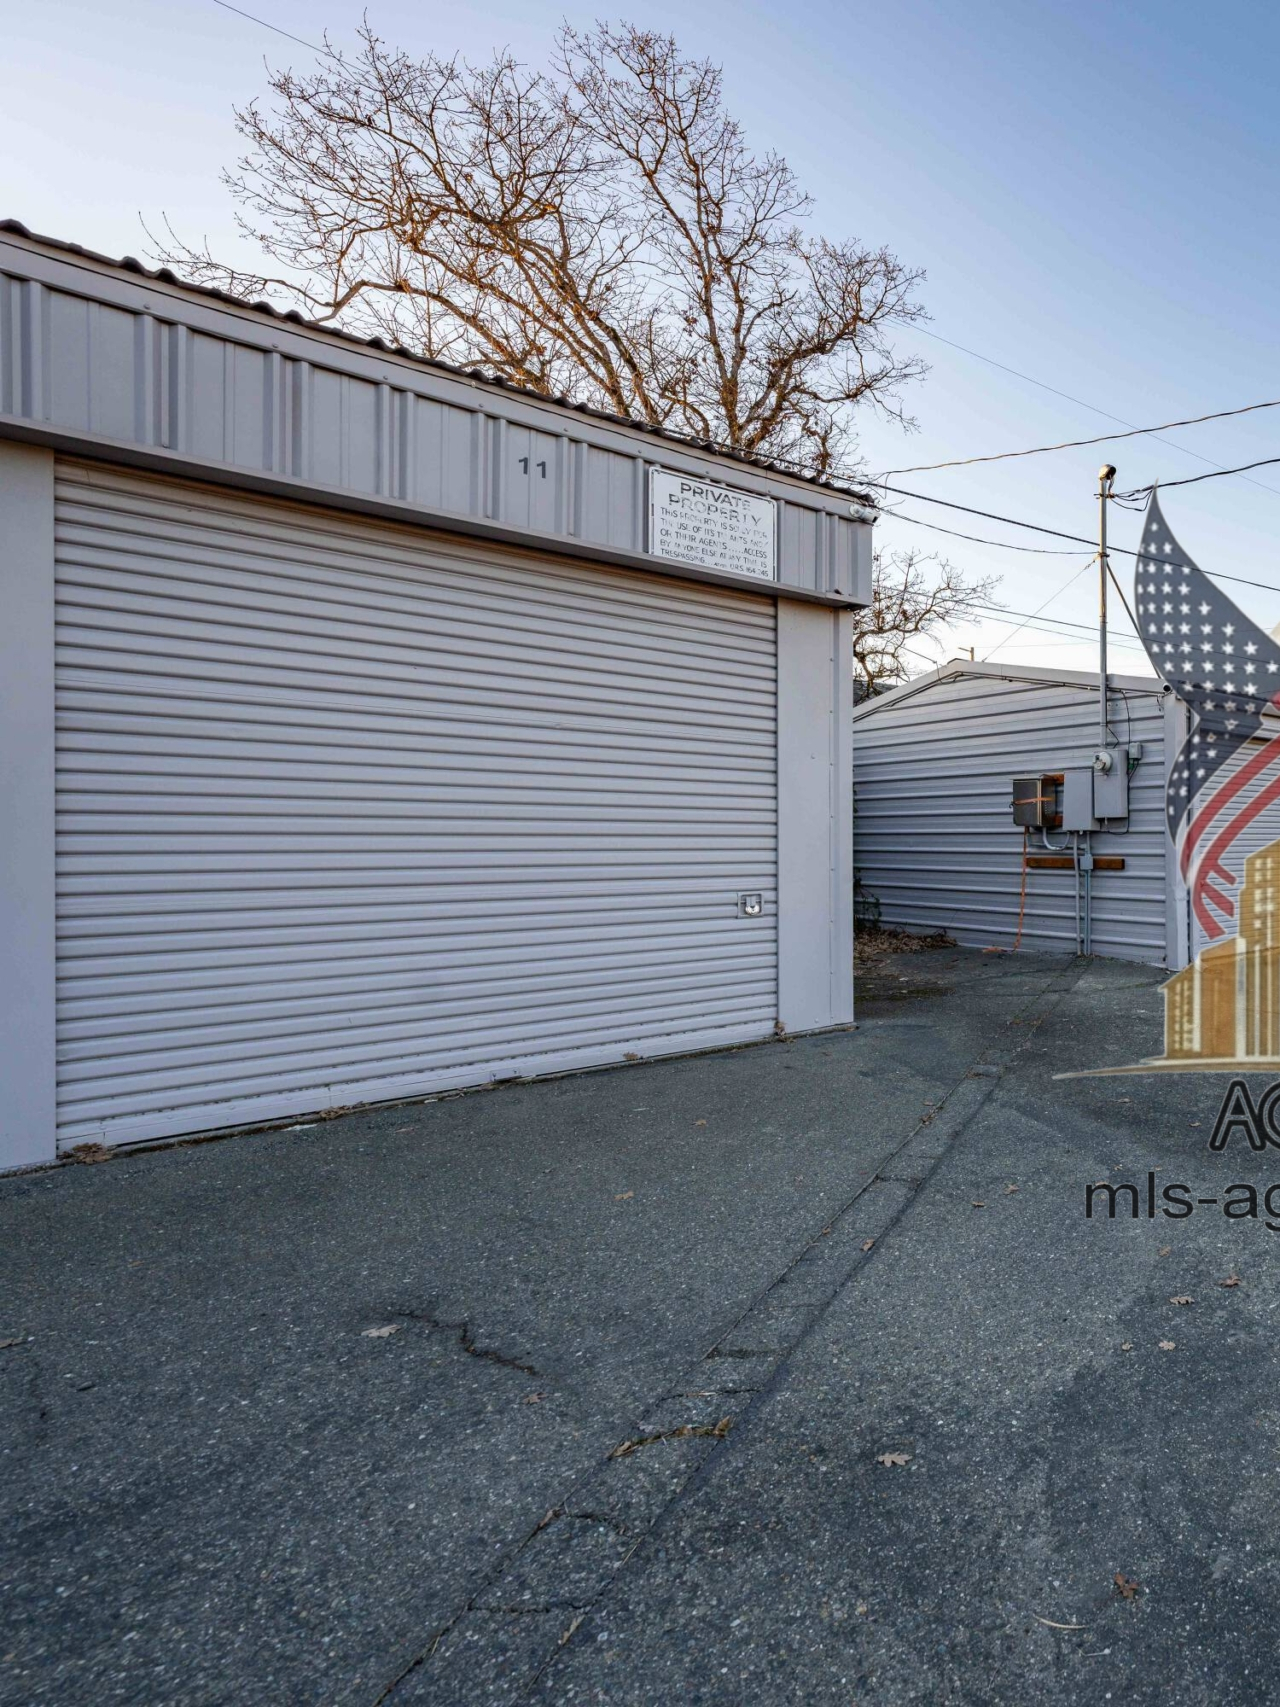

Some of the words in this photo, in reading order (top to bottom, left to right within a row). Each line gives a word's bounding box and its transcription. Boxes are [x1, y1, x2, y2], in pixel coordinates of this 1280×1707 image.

[518, 456, 546, 479] 11
[681, 482, 750, 511] PRIVATE
[660, 506, 678, 518] THIS
[720, 521, 728, 530] IS
[668, 493, 762, 527] PROPERTY
[692, 525, 703, 534] OF
[660, 539, 671, 548] BY
